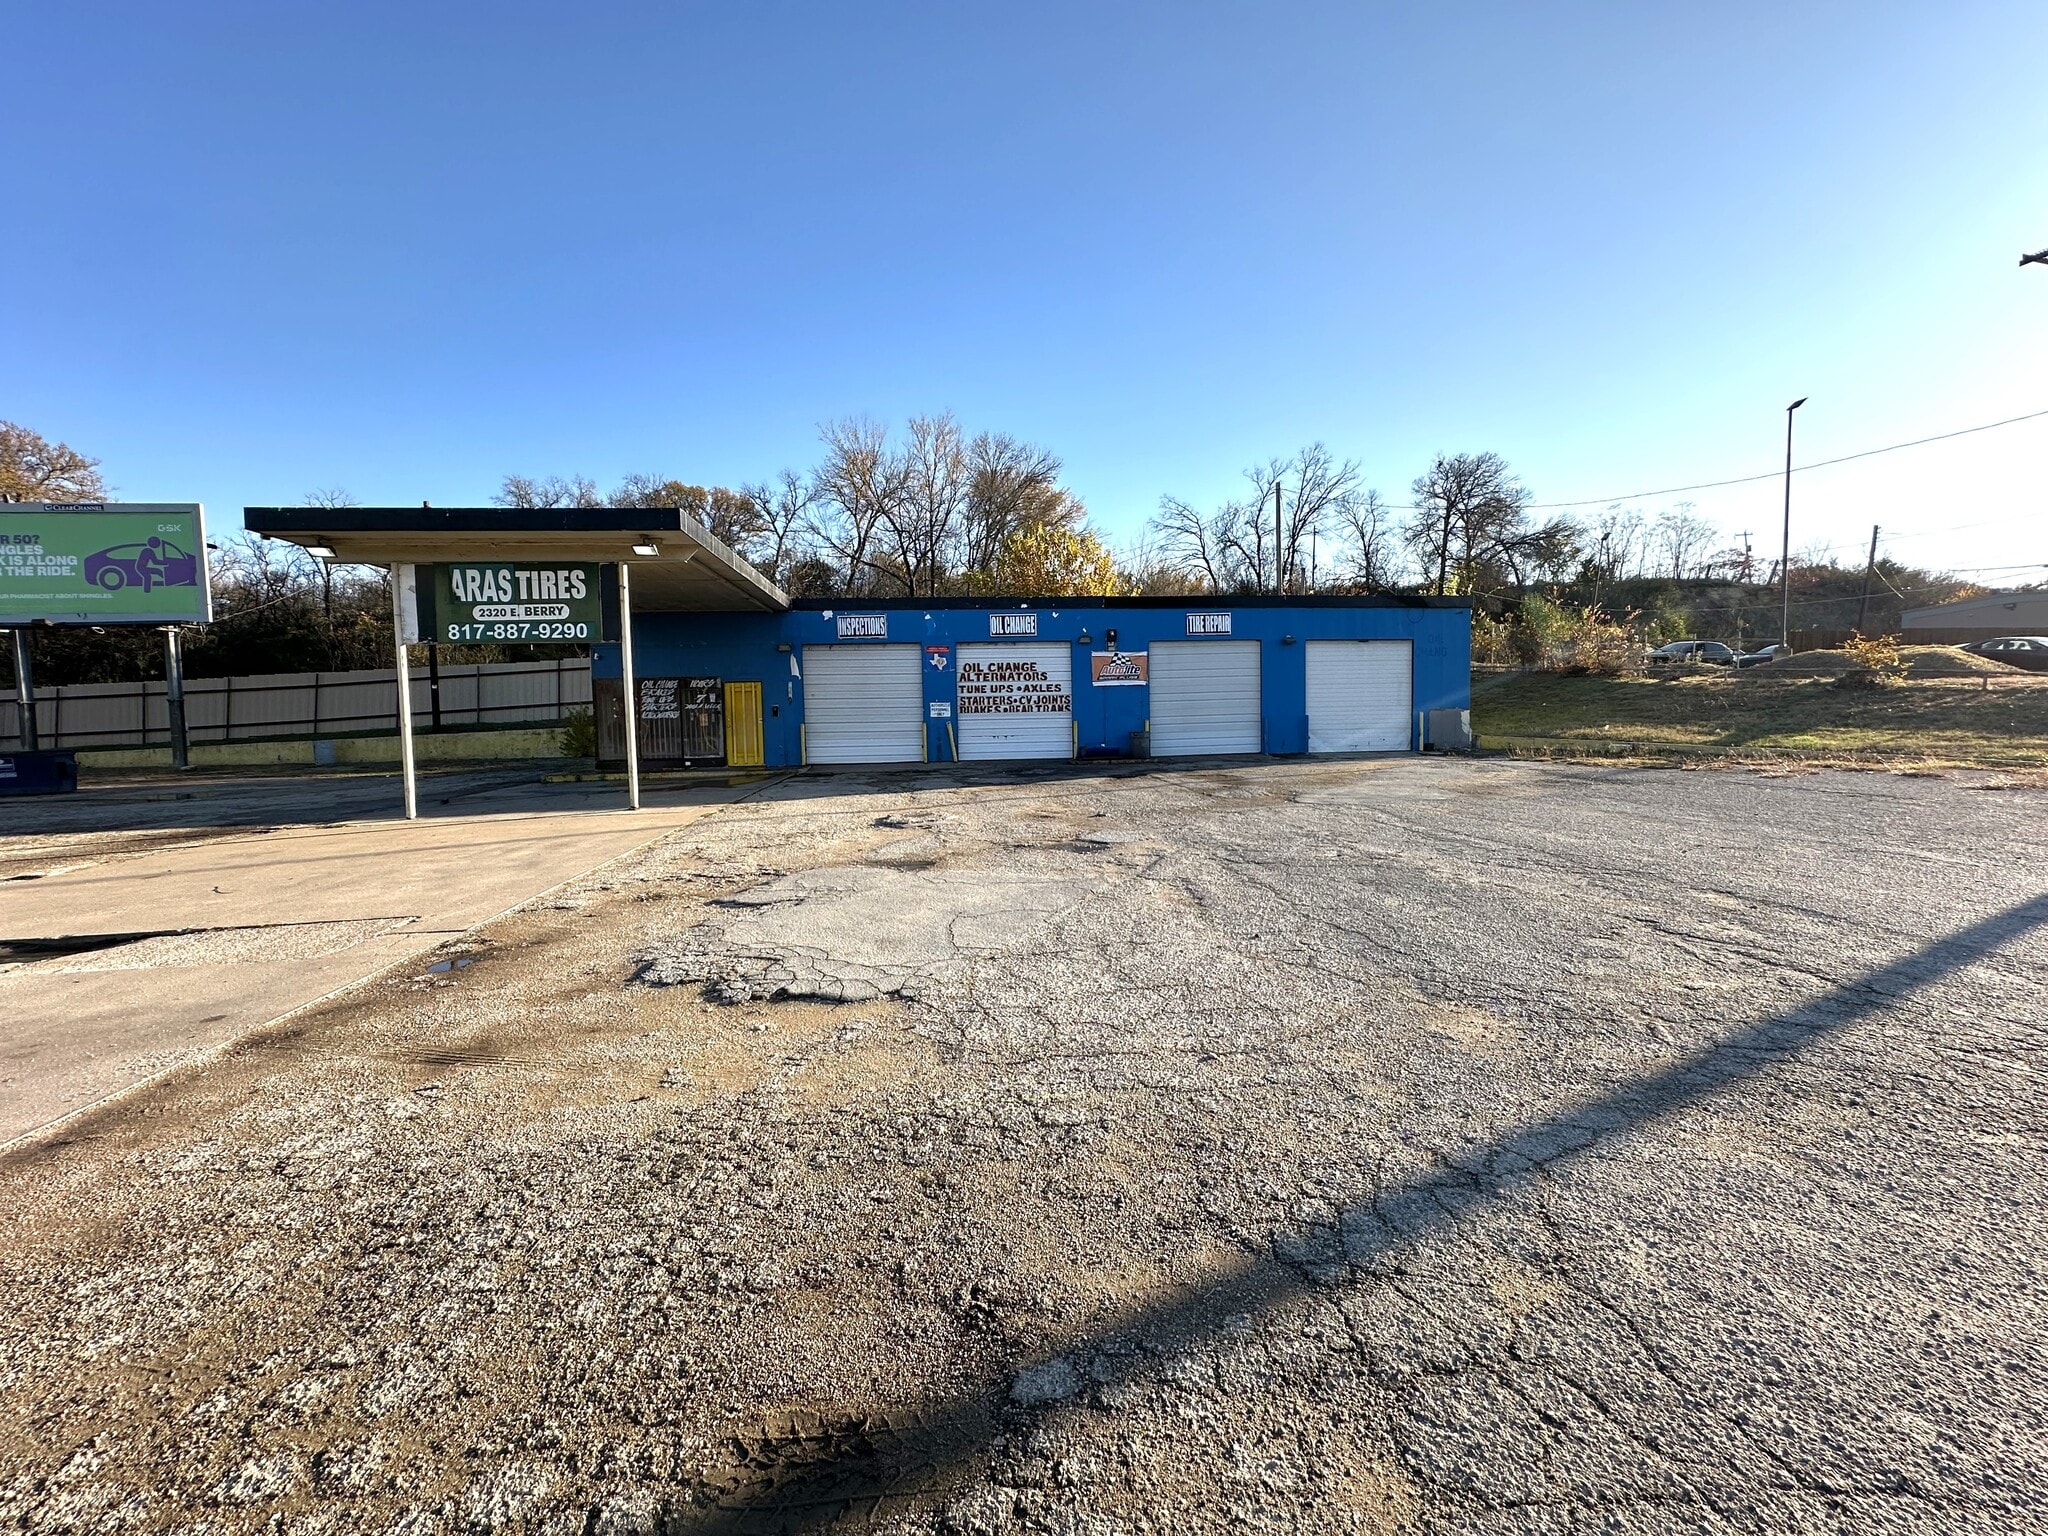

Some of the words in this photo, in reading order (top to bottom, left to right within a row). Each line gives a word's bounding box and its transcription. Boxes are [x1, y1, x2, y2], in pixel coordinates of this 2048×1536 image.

[157, 524, 182, 532] GSK
[13, 534, 40, 544] 50?
[9, 556, 23, 566] IS
[26, 555, 78, 566] ALONG
[5, 567, 34, 576] THE
[37, 566, 76, 576] RIDE.
[451, 568, 513, 603] ARAS
[514, 569, 586, 600] TIRES
[478, 608, 507, 618] 2320
[510, 608, 520, 617] E.
[524, 606, 564, 617] BERRY
[838, 616, 885, 636] INSPECTIONS
[991, 616, 1004, 634] OIL
[1004, 616, 1035, 634] CHANGE
[1188, 615, 1205, 633] TIRE
[1205, 615, 1231, 633] REPAIR
[448, 623, 588, 640] 817-887-9290
[963, 662, 984, 673] OIL
[988, 662, 1037, 672] CHANGE
[1100, 665, 1141, 675] Autolite
[960, 671, 1048, 682] ALTERNATORS
[958, 685, 987, 694] TUNE
[990, 684, 1014, 693] UPS
[1022, 684, 1062, 693] AXLES
[960, 696, 1013, 706] STARTERS
[1020, 695, 1032, 705] CV
[1033, 695, 1071, 705] JOINTS
